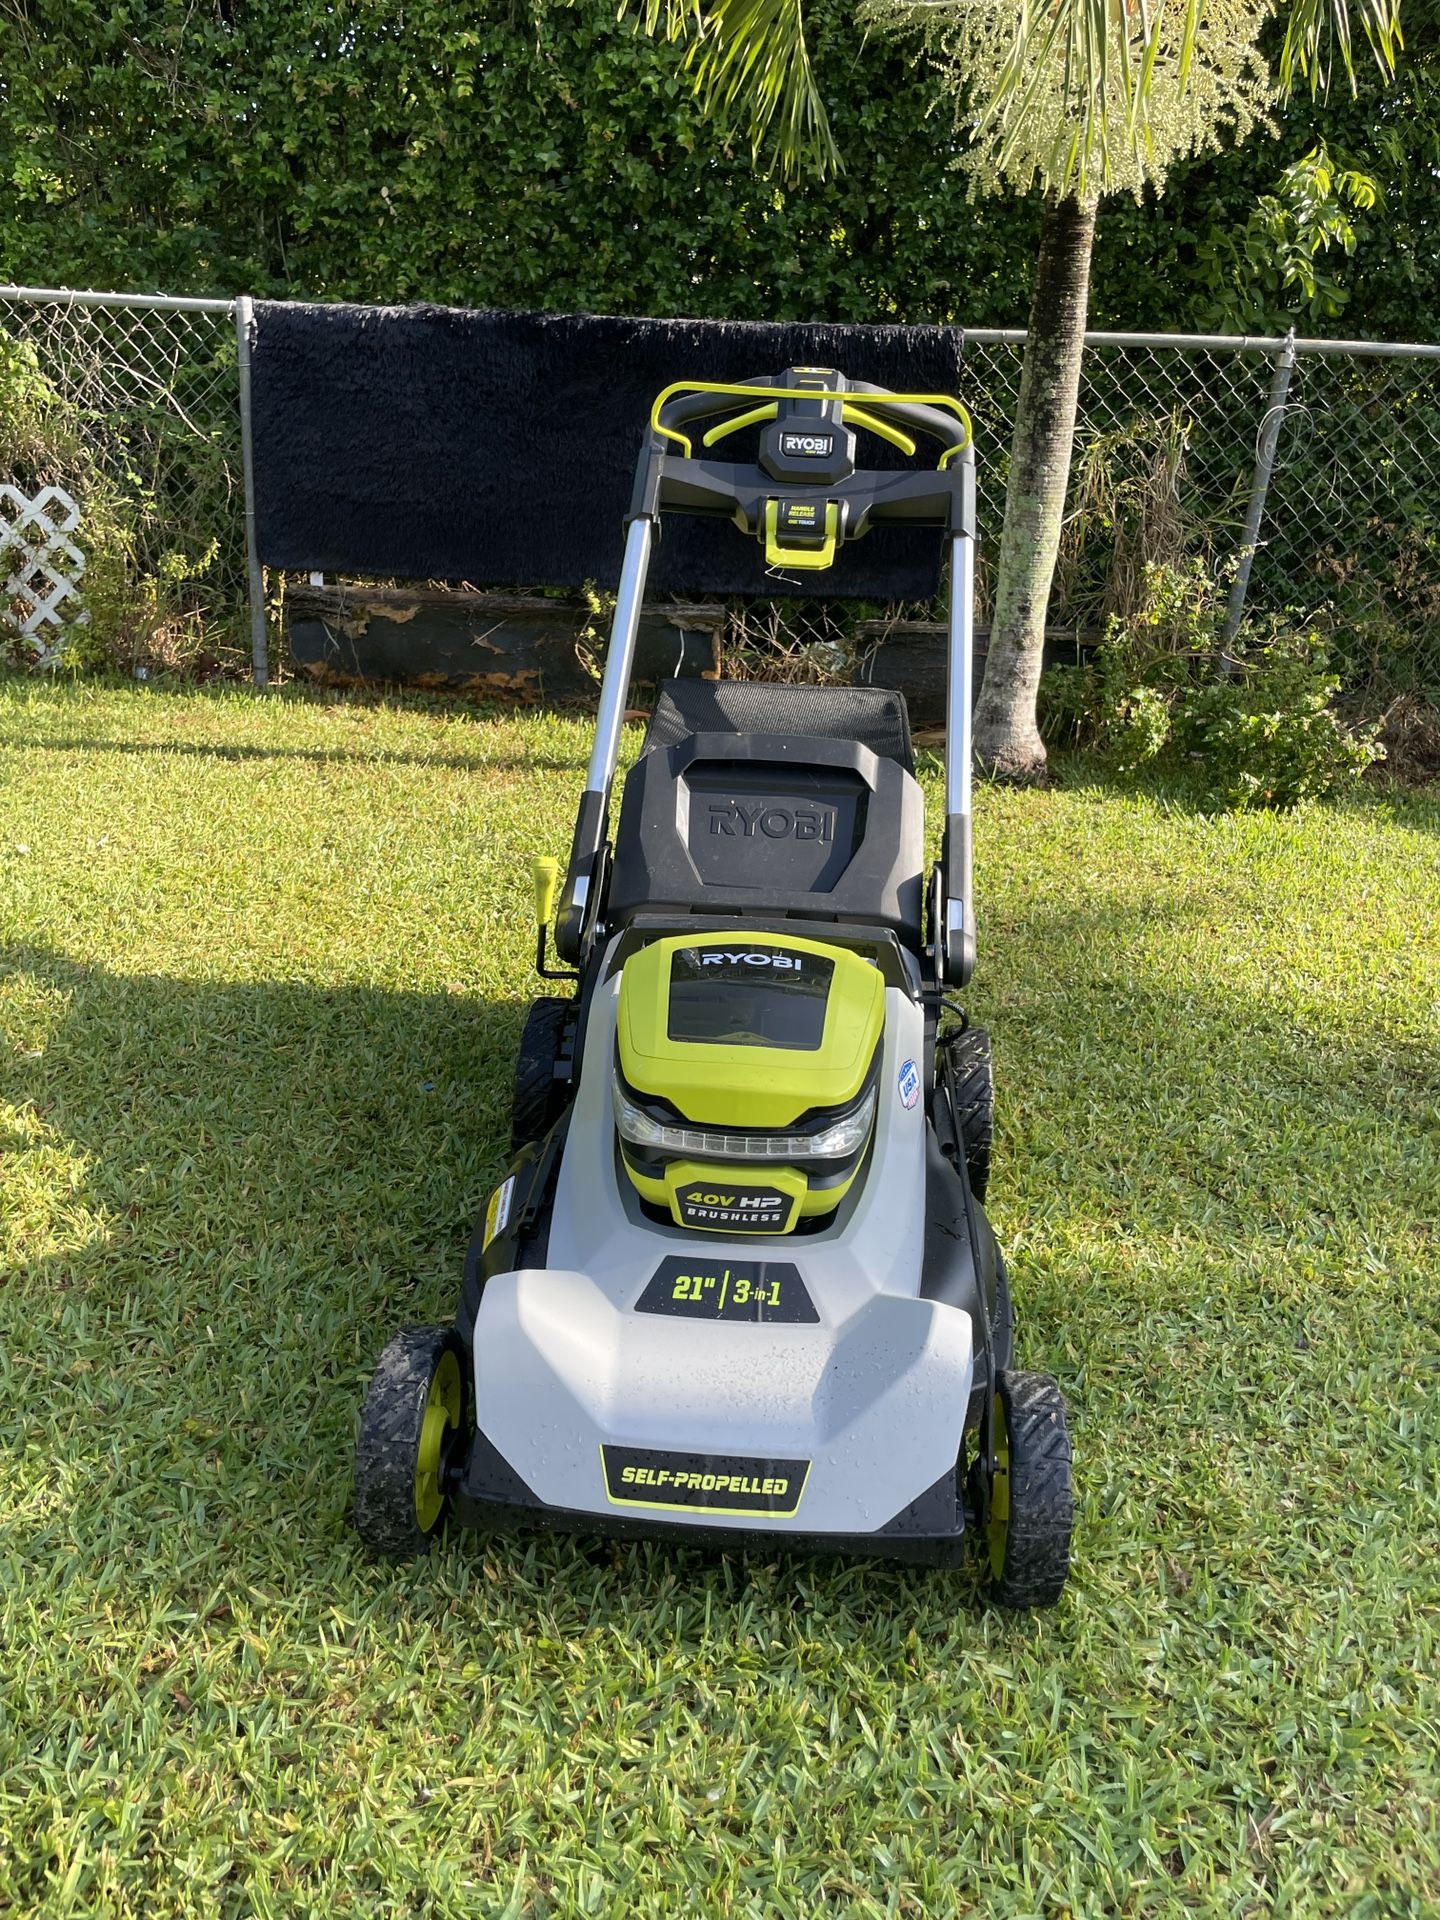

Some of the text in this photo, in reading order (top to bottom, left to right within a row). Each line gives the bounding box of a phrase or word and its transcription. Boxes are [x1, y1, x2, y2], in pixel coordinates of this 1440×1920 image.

[786, 437, 828, 451] RYOBI
[708, 804, 835, 841] RYOBI
[702, 953, 802, 971] RYOBI
[903, 1073, 916, 1098] USA
[686, 1192, 782, 1208] 40V HP
[687, 1207, 781, 1222] BRUSHLESS
[672, 1275, 781, 1306] 21" 3-in-1
[621, 1466, 789, 1495] SELF-PROPELLED
